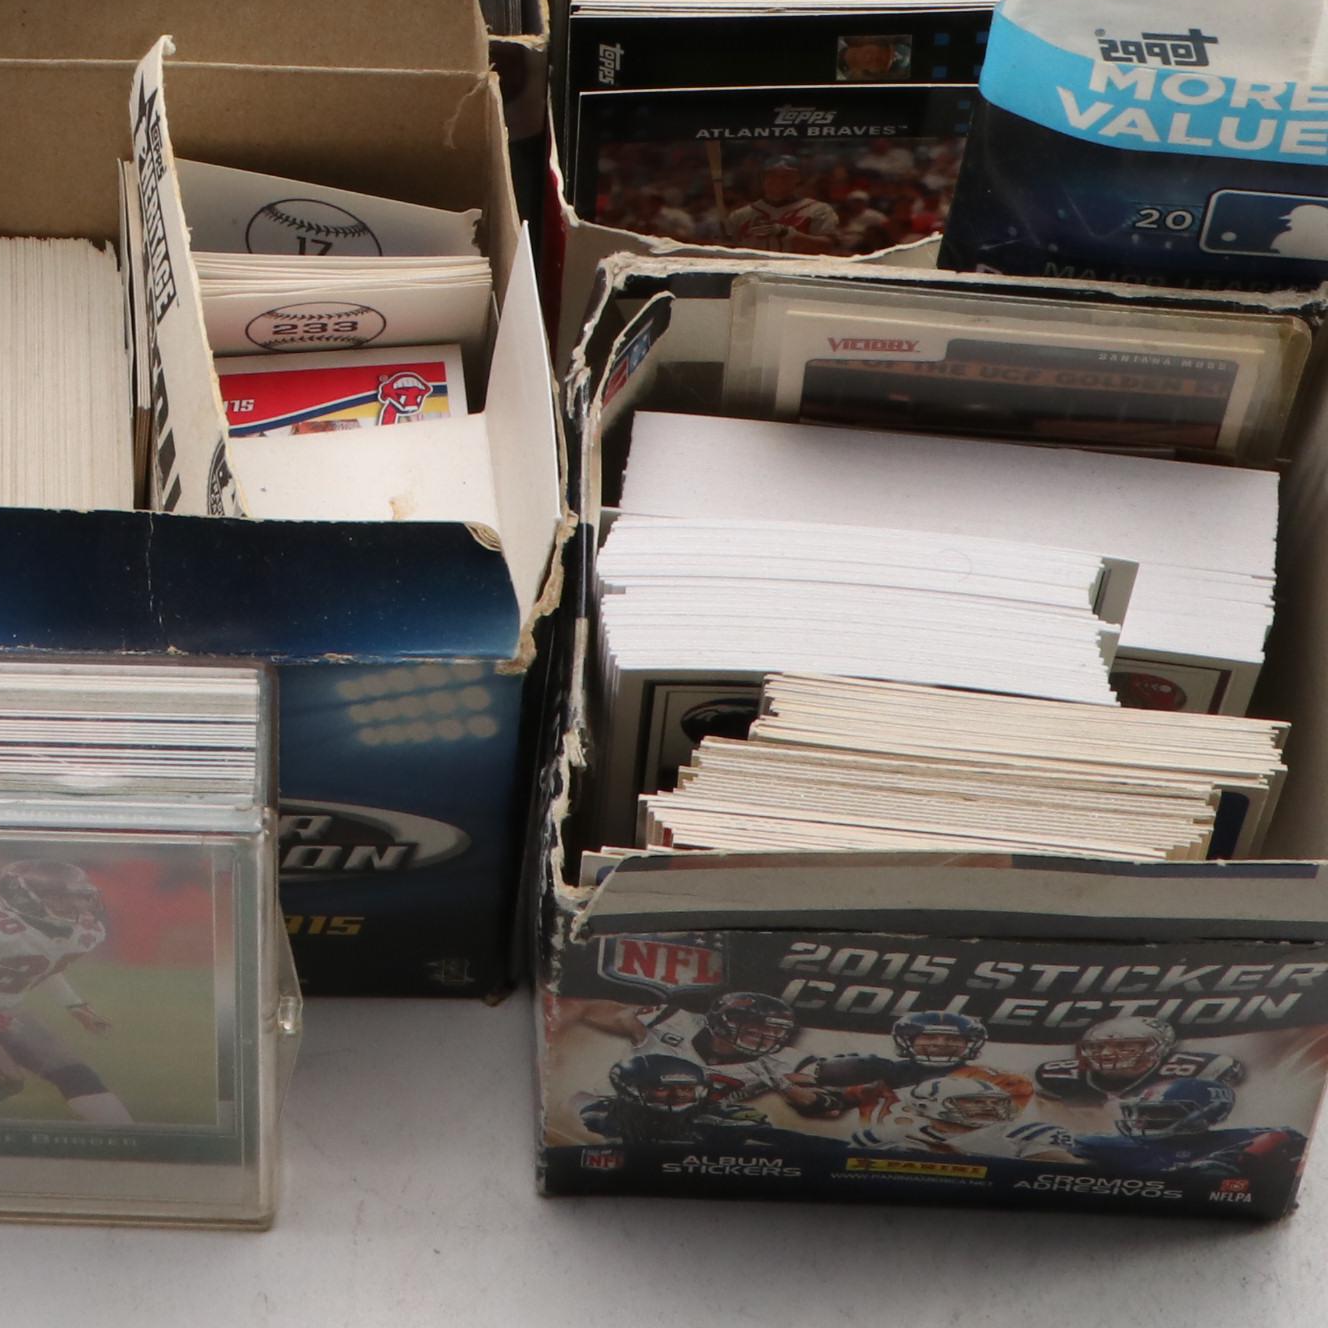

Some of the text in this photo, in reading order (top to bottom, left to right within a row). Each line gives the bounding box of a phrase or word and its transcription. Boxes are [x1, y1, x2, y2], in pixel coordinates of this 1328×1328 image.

[1089, 60, 1328, 112] MORE
[695, 124, 897, 140] ATLANTA BRAVES
[1056, 86, 1328, 156] VALUE
[1131, 206, 1193, 231] 20
[270, 317, 360, 337] 233
[826, 337, 921, 354] VICTORY
[621, 940, 723, 985] NFL
[779, 942, 1328, 996] 2015 STICKER
[779, 978, 1302, 1028] COLLECTION
[662, 1164, 802, 1178] STICKERS
[682, 1156, 784, 1168] ALBUM
[1208, 1190, 1253, 1204] NFLPA
